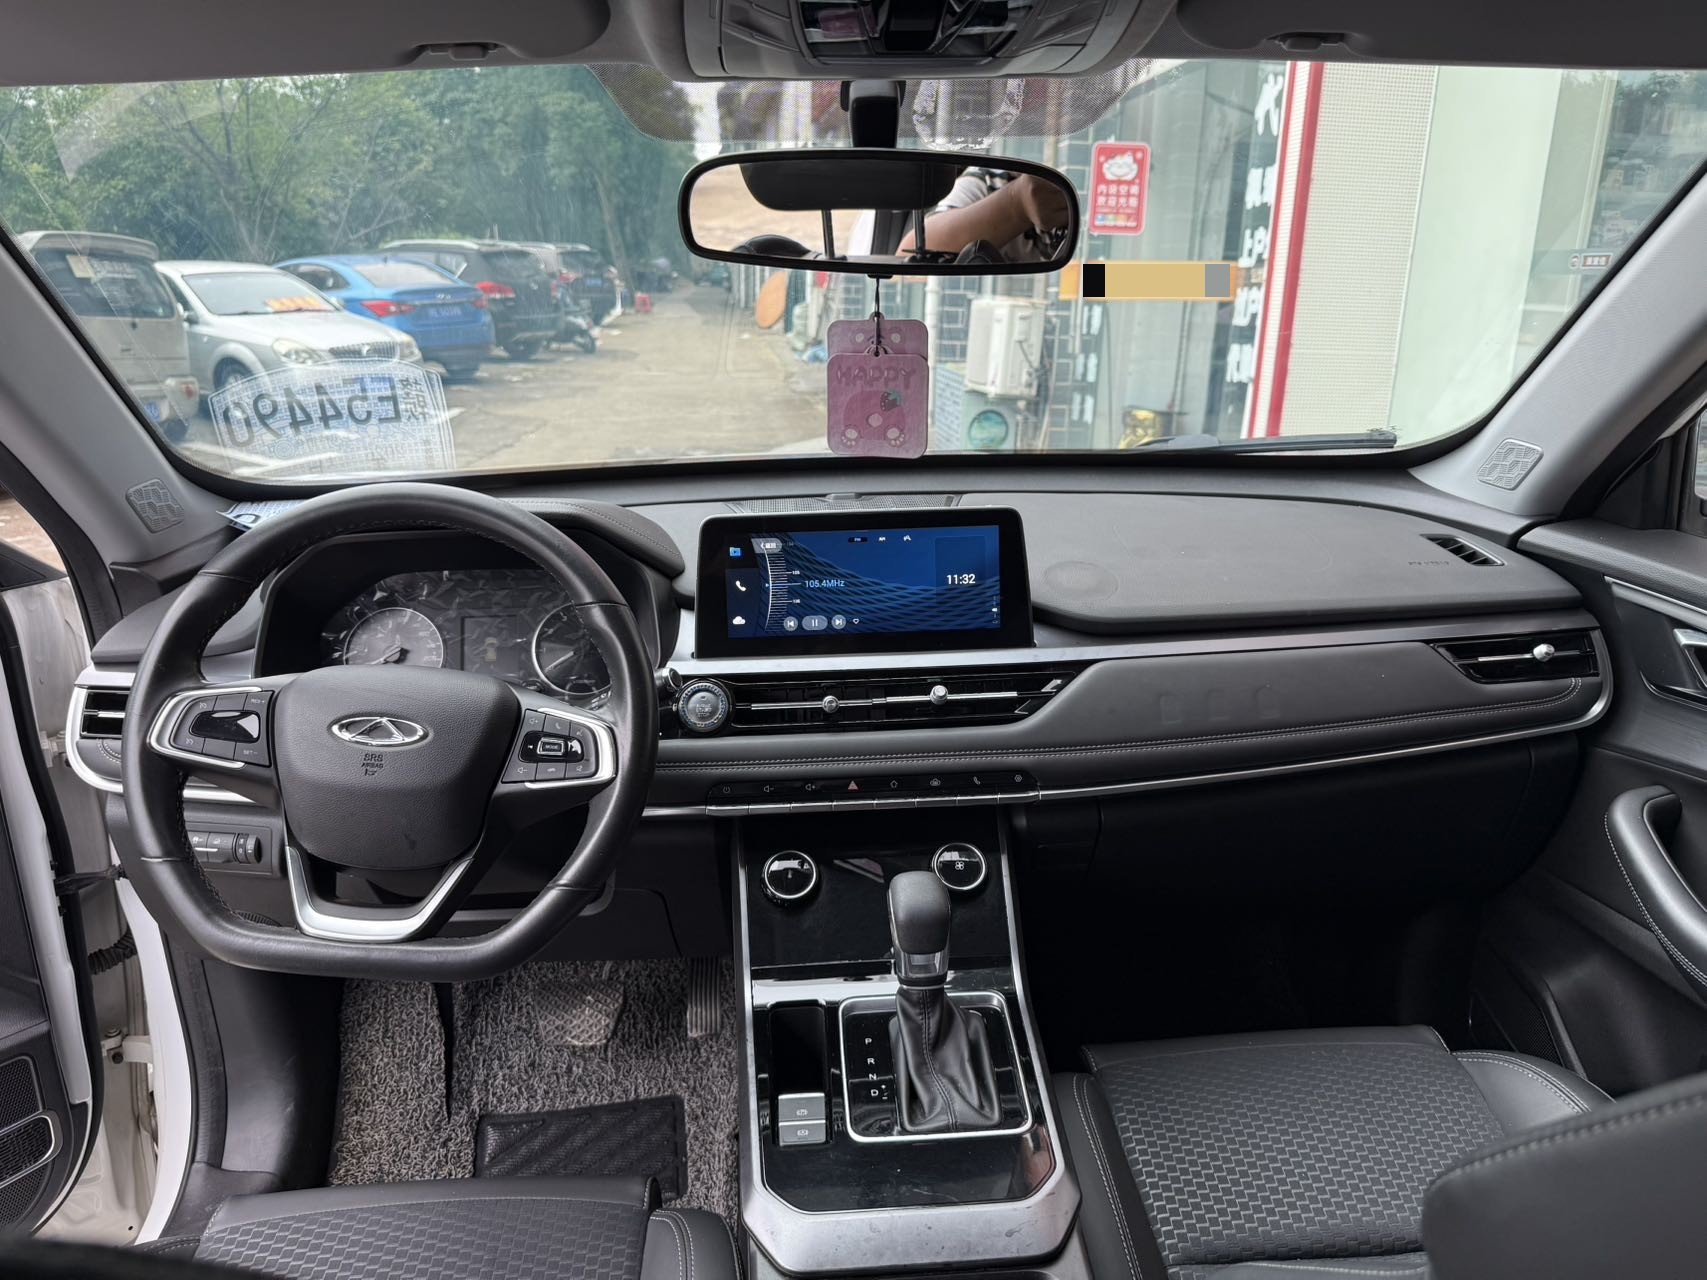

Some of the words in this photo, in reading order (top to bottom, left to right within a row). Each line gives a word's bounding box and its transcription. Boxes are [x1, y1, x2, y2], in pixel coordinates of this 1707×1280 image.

[836, 366, 915, 389] HAPPY
[946, 573, 977, 586] 11:32
[804, 580, 845, 589] 105.4MHz
[363, 753, 384, 762] SRS
[864, 1037, 872, 1045] P
[867, 1057, 876, 1065] R
[870, 1089, 879, 1097] D
